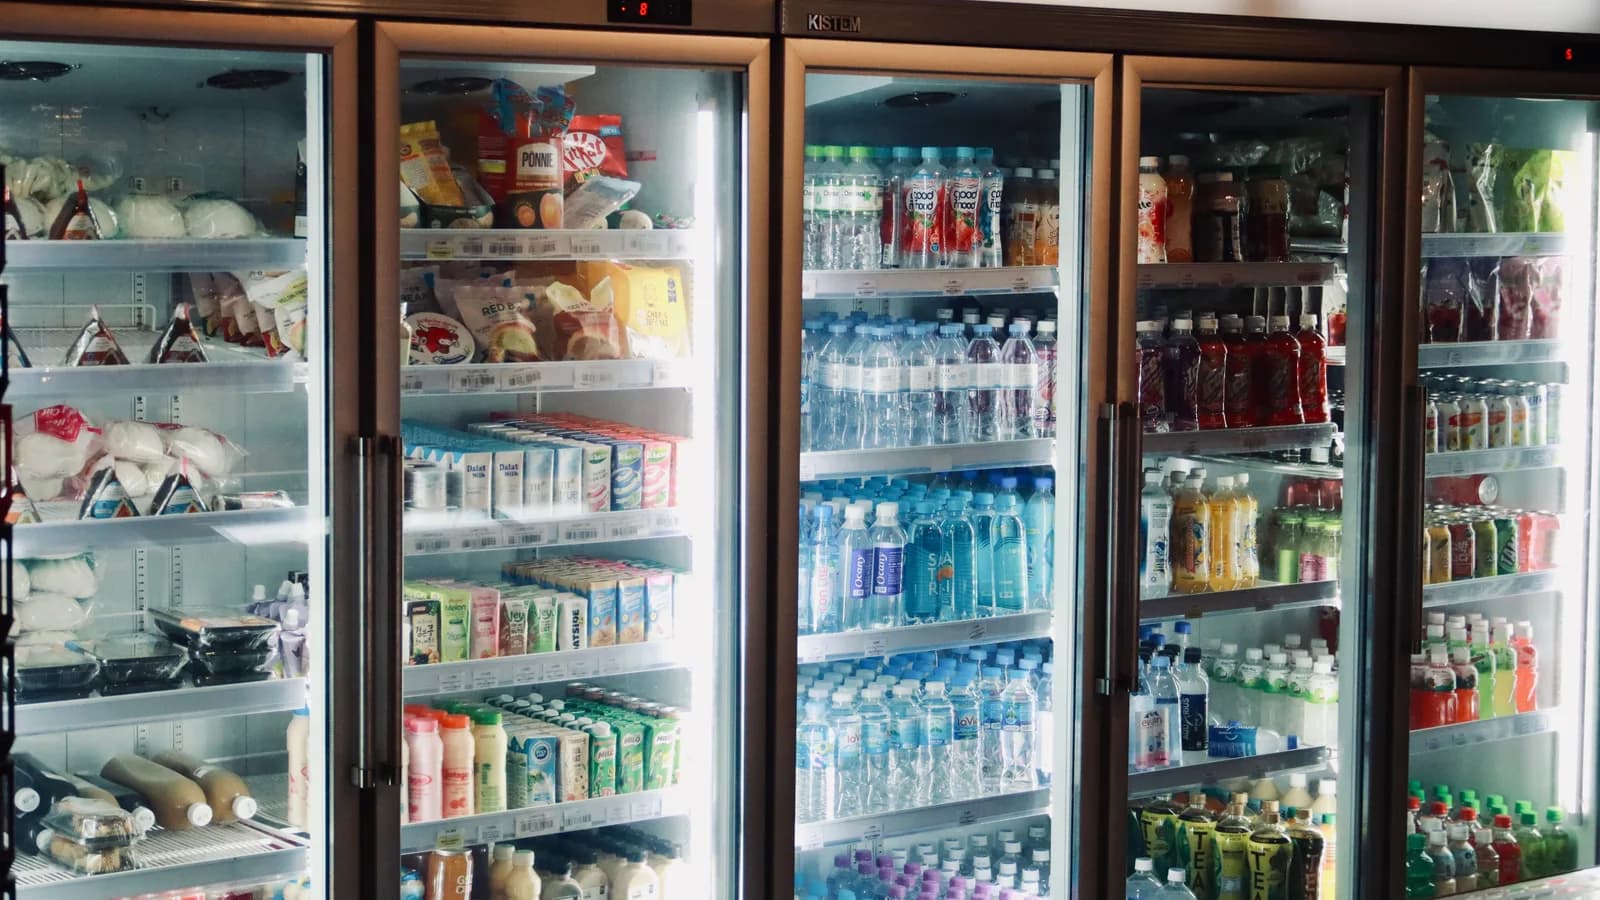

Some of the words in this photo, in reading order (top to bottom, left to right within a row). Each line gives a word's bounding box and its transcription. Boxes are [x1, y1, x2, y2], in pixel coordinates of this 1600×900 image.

[640, 1, 648, 16] 8
[807, 13, 862, 33] KISTEM
[854, 556, 866, 588] Ocany
[876, 553, 888, 585] Ocany
[571, 608, 580, 650] ATSIDE
[1192, 831, 1209, 893] TEA
